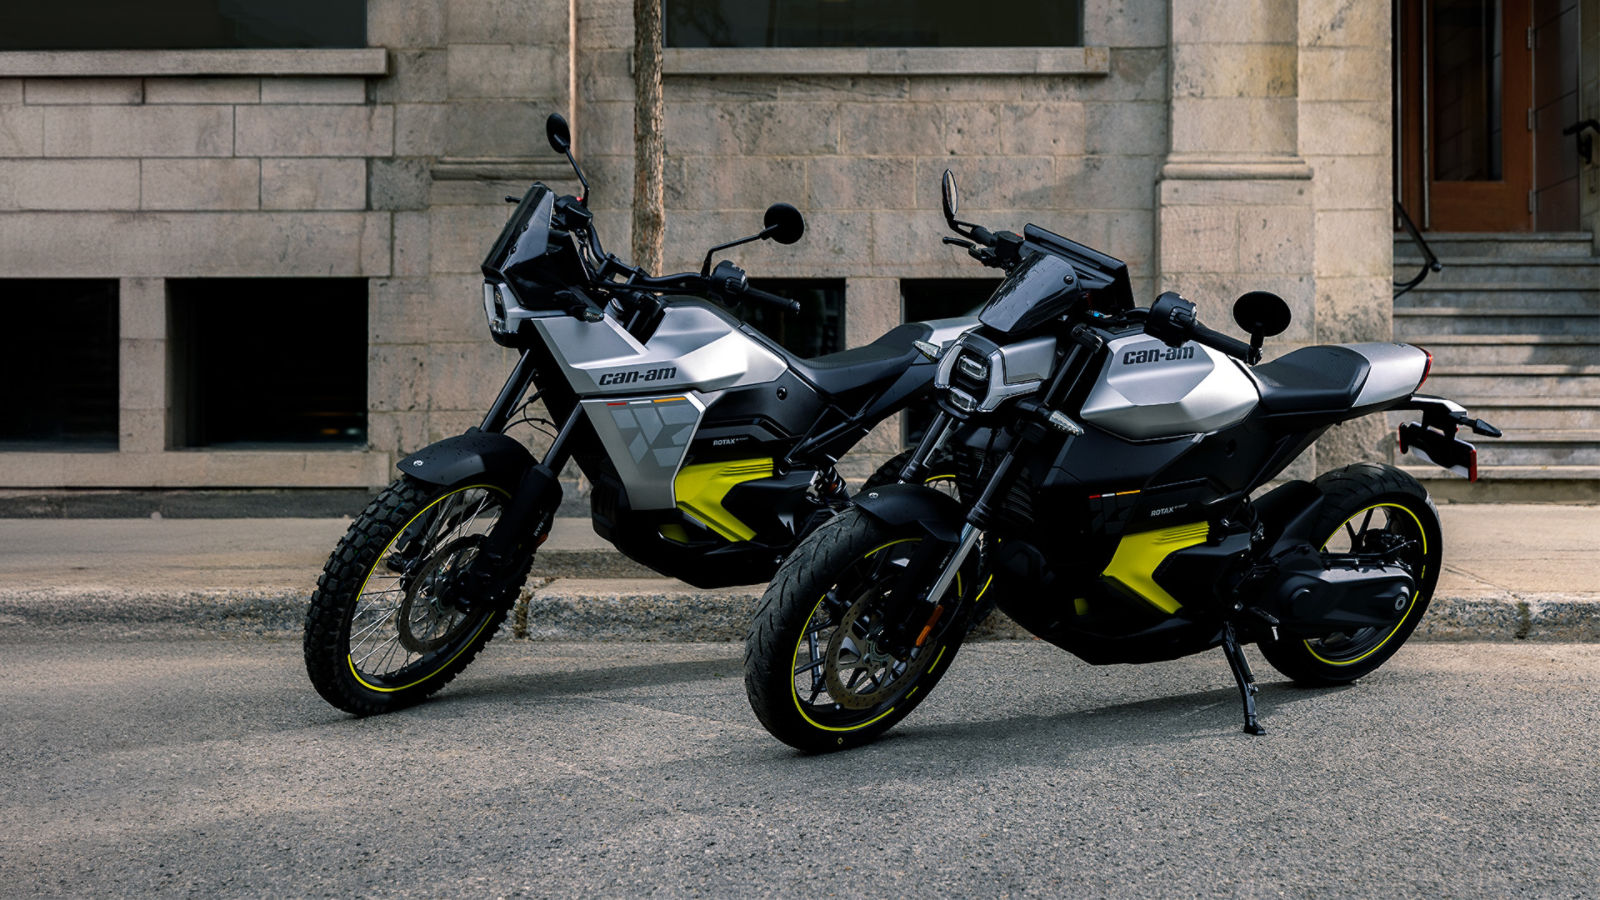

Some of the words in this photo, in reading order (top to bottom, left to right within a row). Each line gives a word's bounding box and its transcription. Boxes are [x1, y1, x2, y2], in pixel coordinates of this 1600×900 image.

[1122, 345, 1195, 365] can-am
[598, 366, 677, 386] can-am
[712, 438, 736, 447] ROTAX
[1150, 506, 1174, 517] ROTAX
